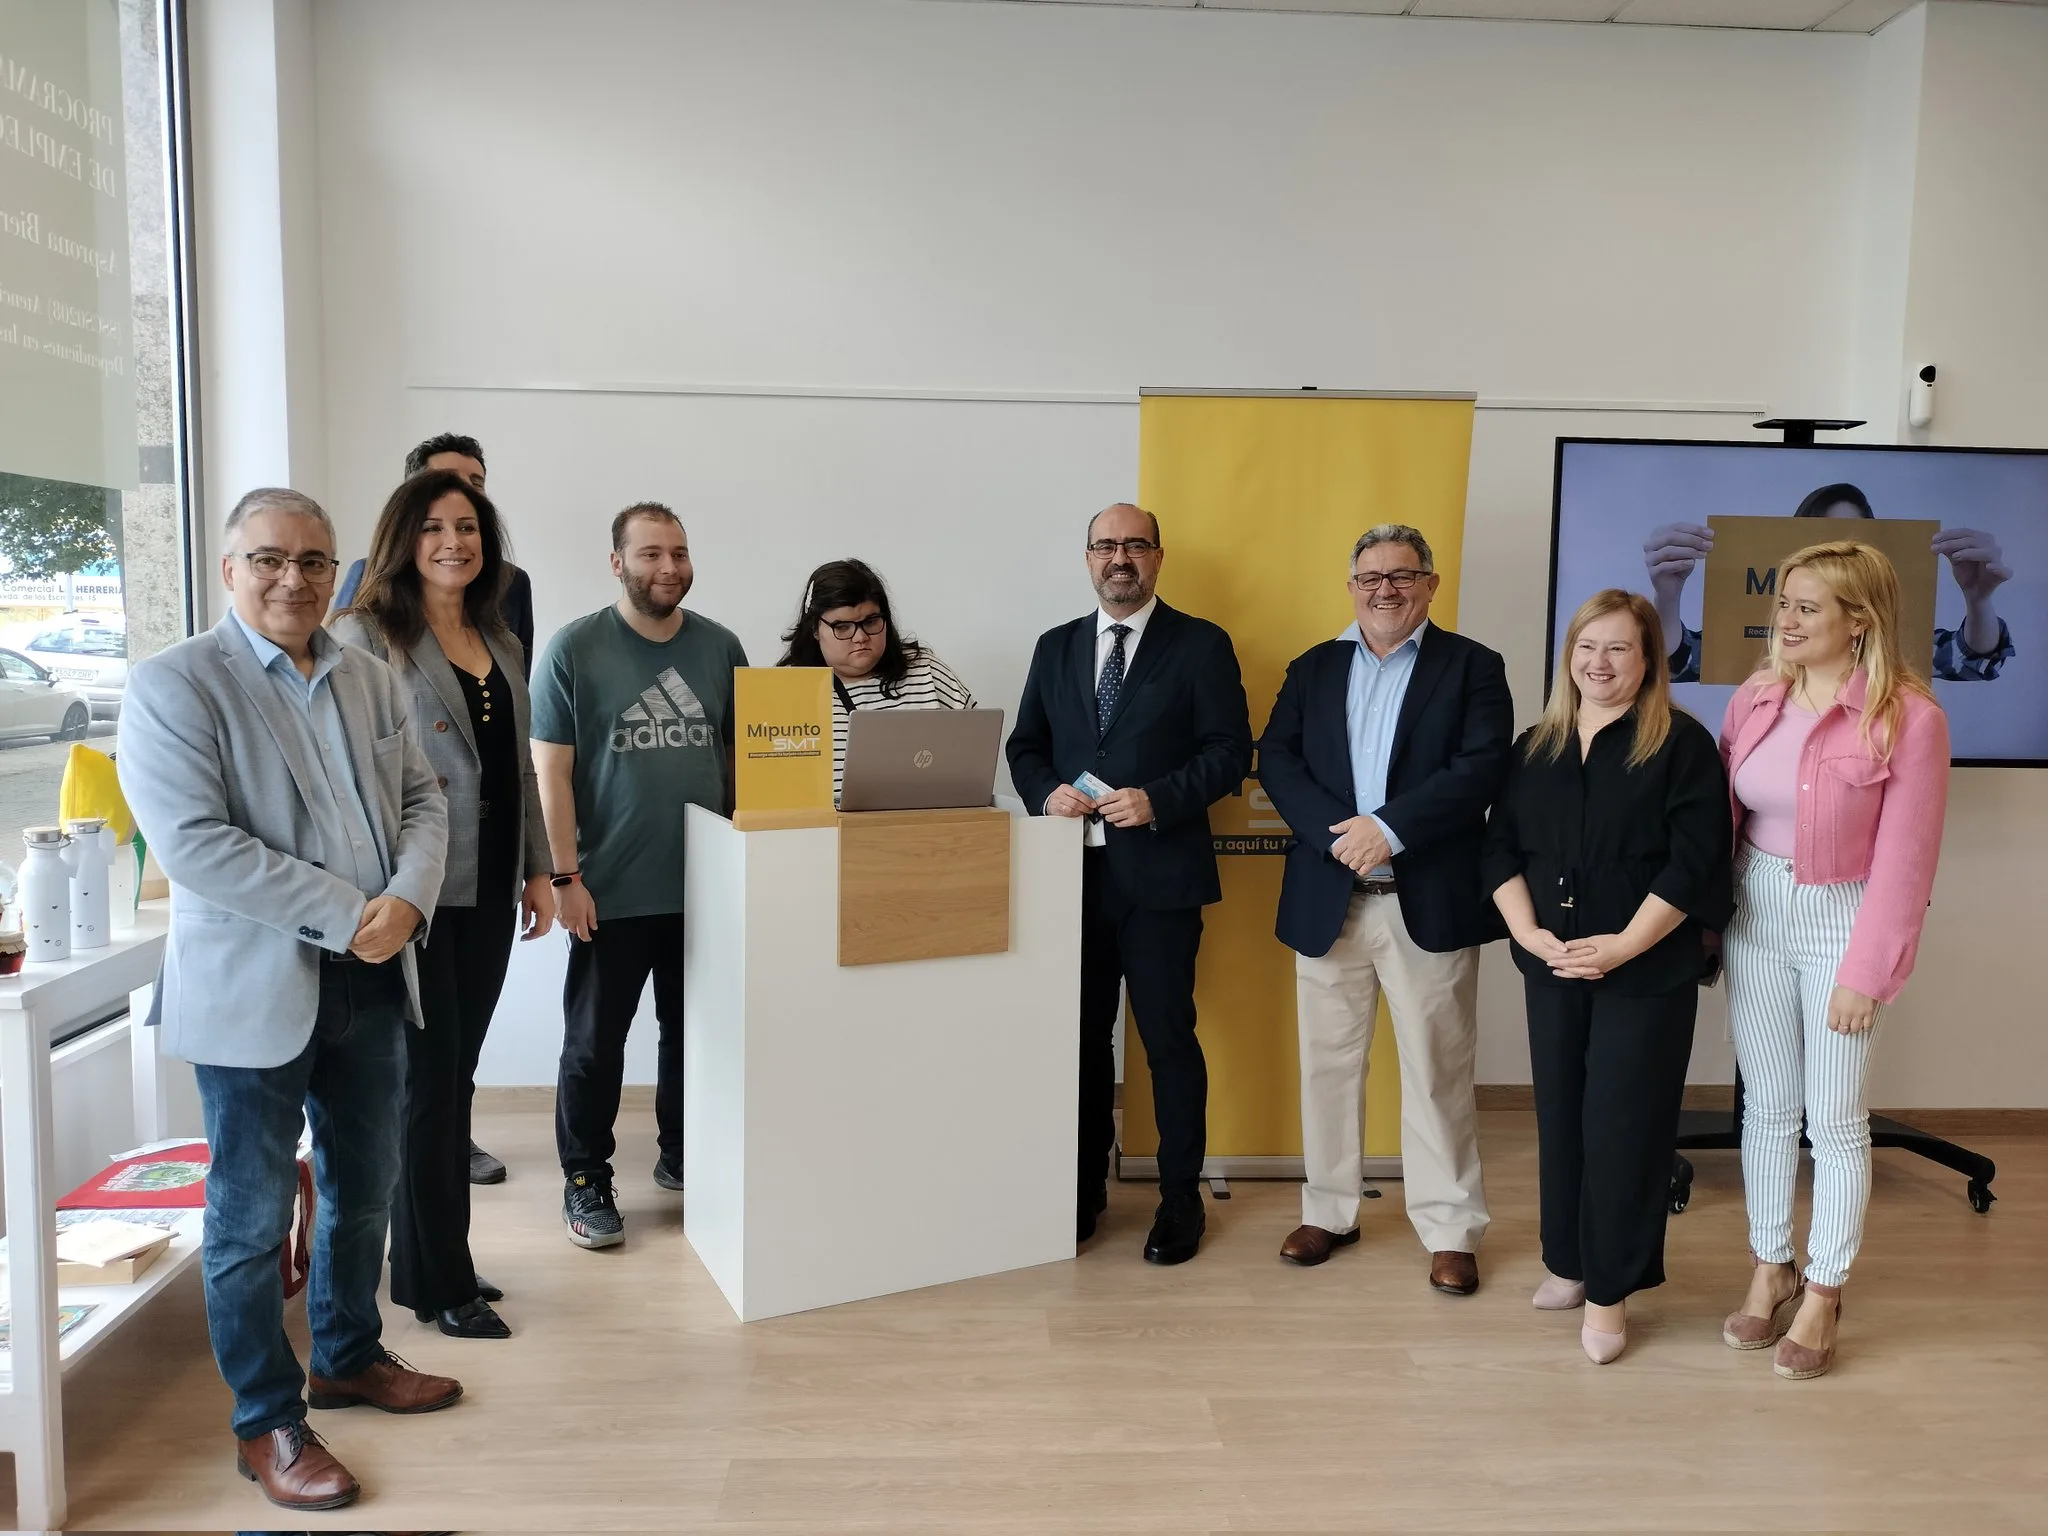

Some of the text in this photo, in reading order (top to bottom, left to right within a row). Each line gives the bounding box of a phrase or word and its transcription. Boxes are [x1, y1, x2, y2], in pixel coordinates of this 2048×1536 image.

[3, 584, 54, 593] Comercial
[609, 718, 715, 753] adidas
[773, 737, 821, 751] SMT
[1226, 837, 1260, 853] aquí
[1263, 838, 1278, 850] tu
